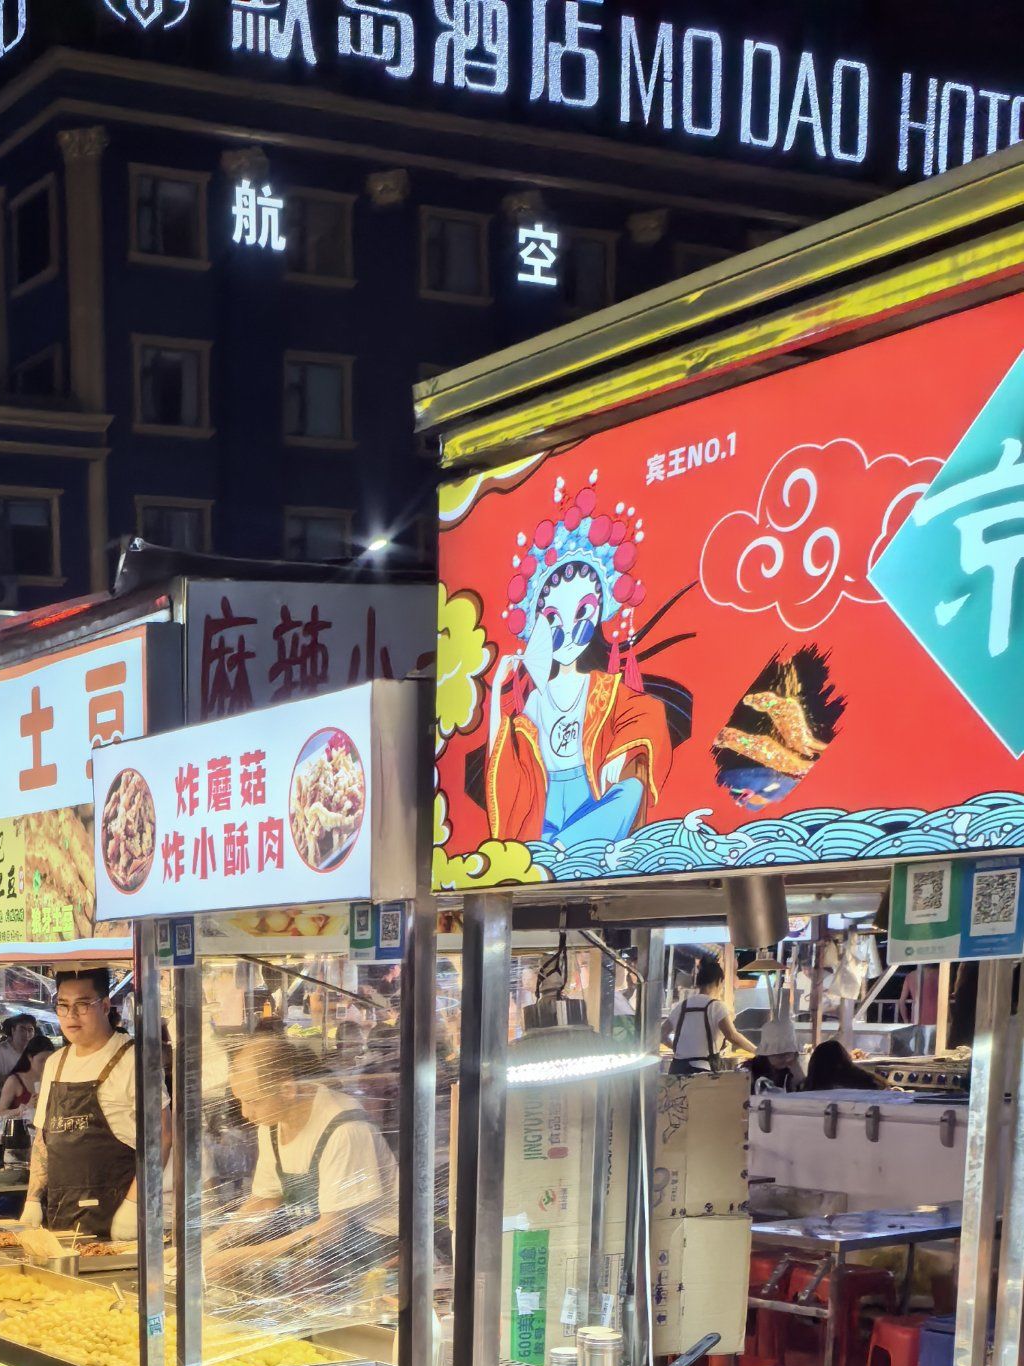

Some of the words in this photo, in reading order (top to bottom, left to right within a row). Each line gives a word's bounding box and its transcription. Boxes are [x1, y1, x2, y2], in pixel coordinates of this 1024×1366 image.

[232, 179, 287, 252] 航
[517, 223, 558, 286] 空
[645, 432, 738, 487] 宾王NO.1
[201, 596, 437, 724] 麻辣小
[175, 749, 267, 818] 炸蘑菇
[161, 816, 285, 885] 炸小酥肉
[522, 1092, 548, 1160] JINGYUYU
